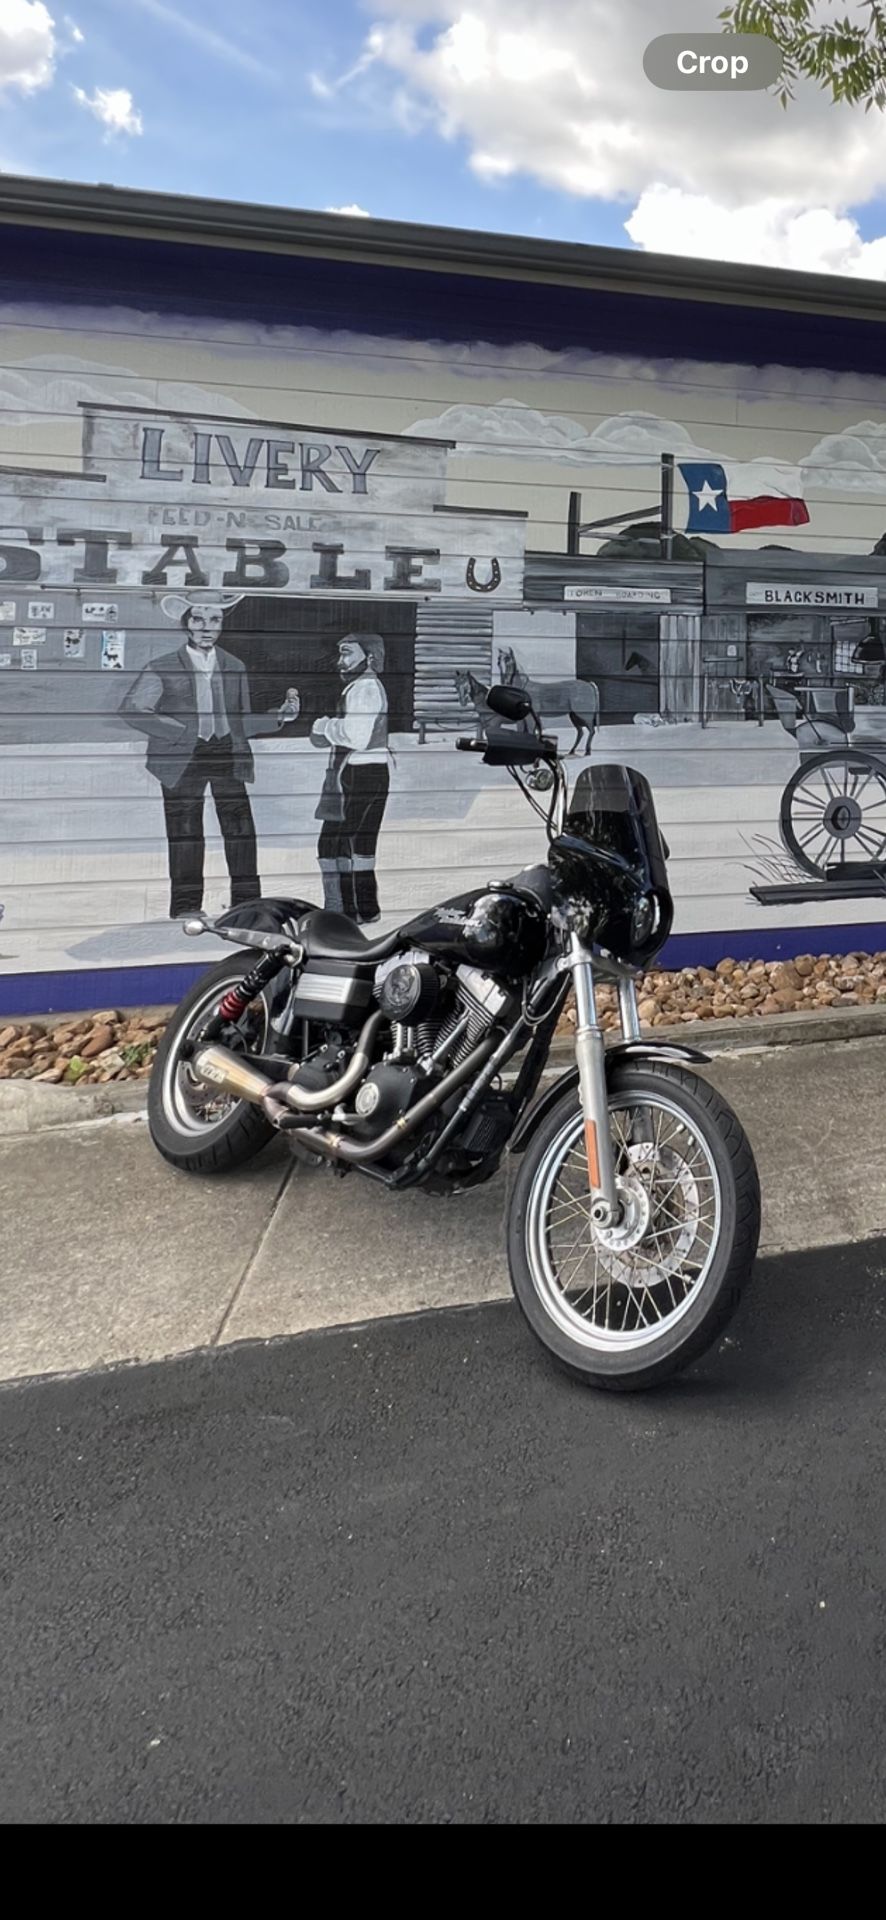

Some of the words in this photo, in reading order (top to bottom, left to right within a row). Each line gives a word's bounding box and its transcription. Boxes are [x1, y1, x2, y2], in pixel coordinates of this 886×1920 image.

[140, 427, 380, 494] LIVERY
[264, 514, 323, 532] SALE
[764, 590, 865, 605] BLACKSMITH
